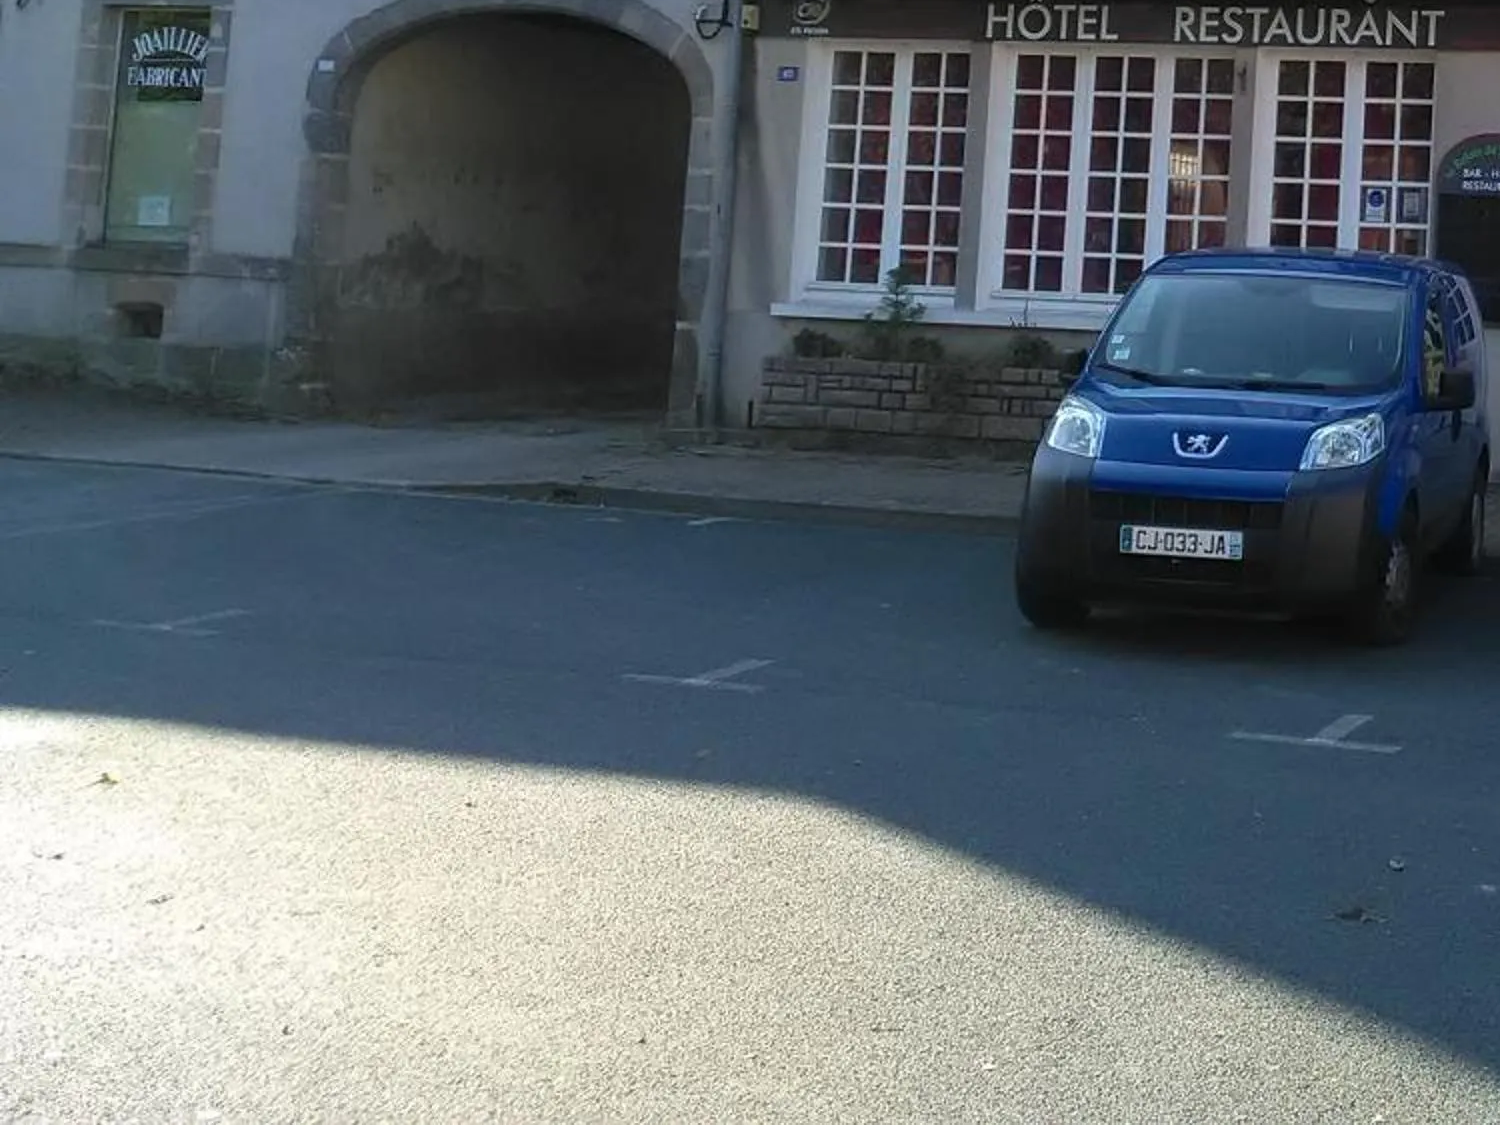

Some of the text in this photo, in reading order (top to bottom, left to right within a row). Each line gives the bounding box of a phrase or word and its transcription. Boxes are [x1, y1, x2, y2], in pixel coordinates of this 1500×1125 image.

[1173, 6, 1445, 47] RESTAURANT
[127, 65, 208, 88] FABRICANT
[1463, 168, 1482, 178] BAR
